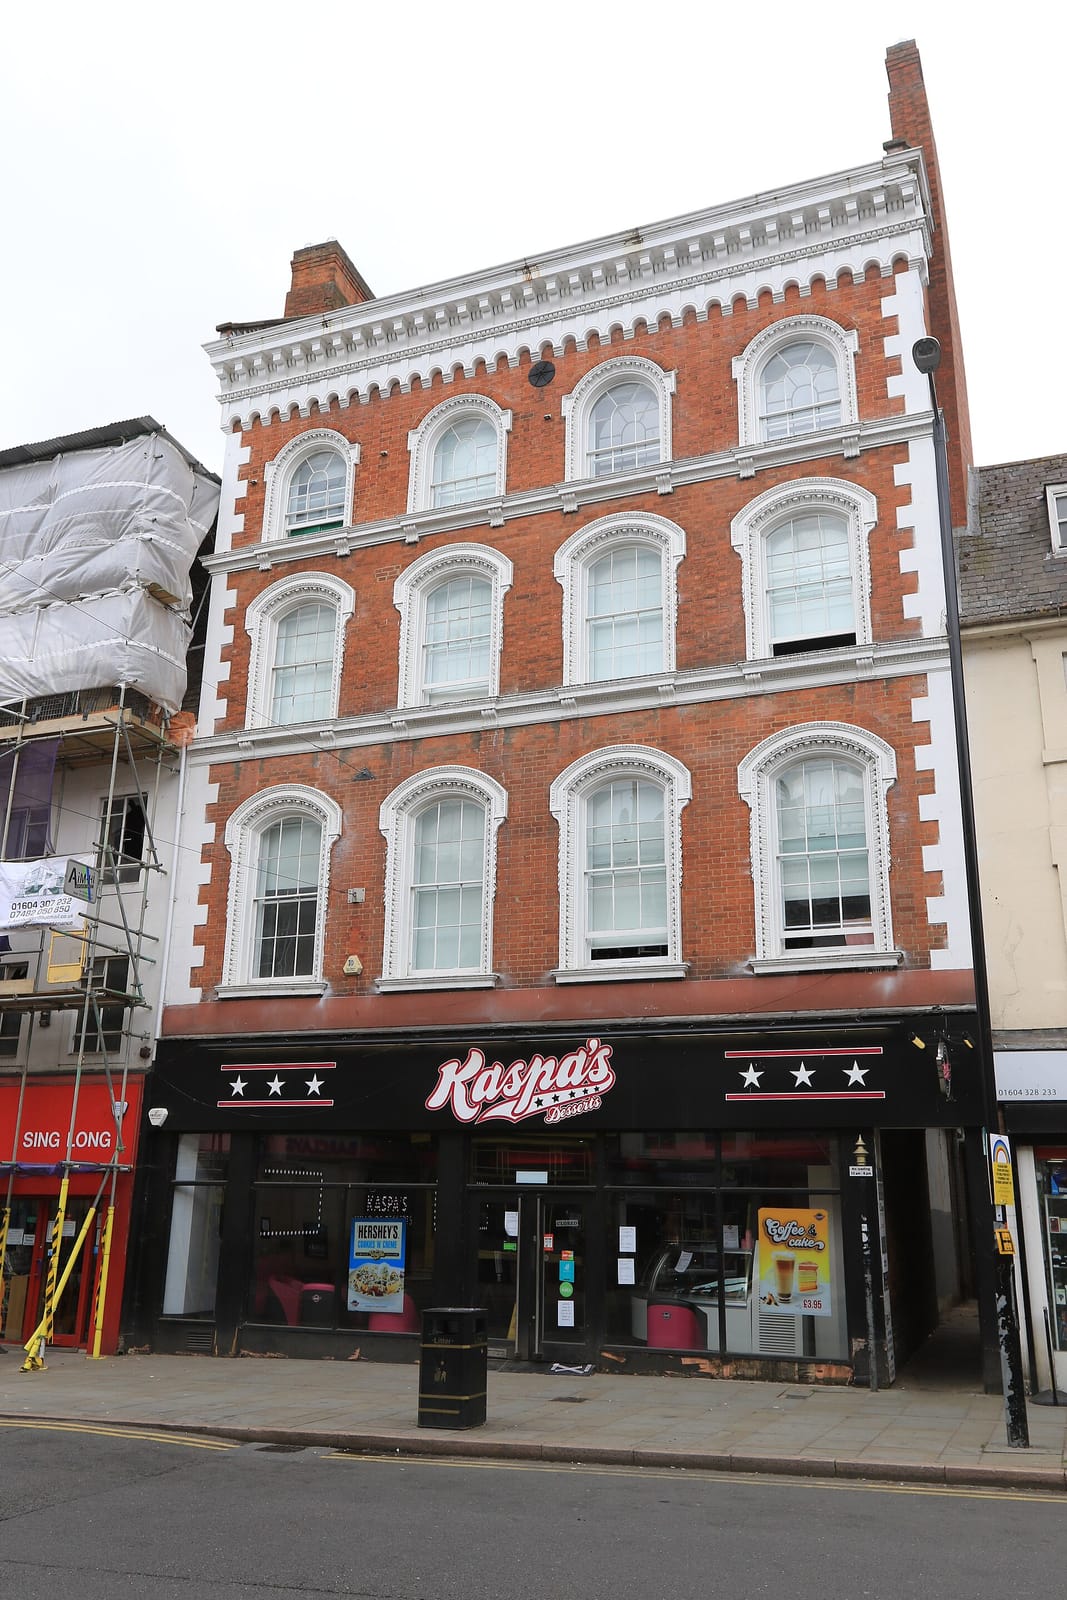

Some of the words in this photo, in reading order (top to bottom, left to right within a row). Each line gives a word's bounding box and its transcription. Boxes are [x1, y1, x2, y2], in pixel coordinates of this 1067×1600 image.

[11, 901, 38, 911] 01604
[40, 899, 55, 909] 307
[56, 897, 73, 906] 232
[425, 1038, 616, 1122] Kaspa's
[1024, 1088, 1040, 1096] 328
[1042, 1088, 1057, 1096] 233
[544, 1095, 601, 1124] Desserts
[22, 1131, 61, 1148] SING
[366, 1194, 408, 1212] KASPA'S
[358, 1224, 399, 1240] HERSHEY'S
[764, 1217, 806, 1243] Coffee
[808, 1223, 818, 1237] &
[787, 1237, 826, 1251] cake
[802, 1299, 823, 1310] £3.95
